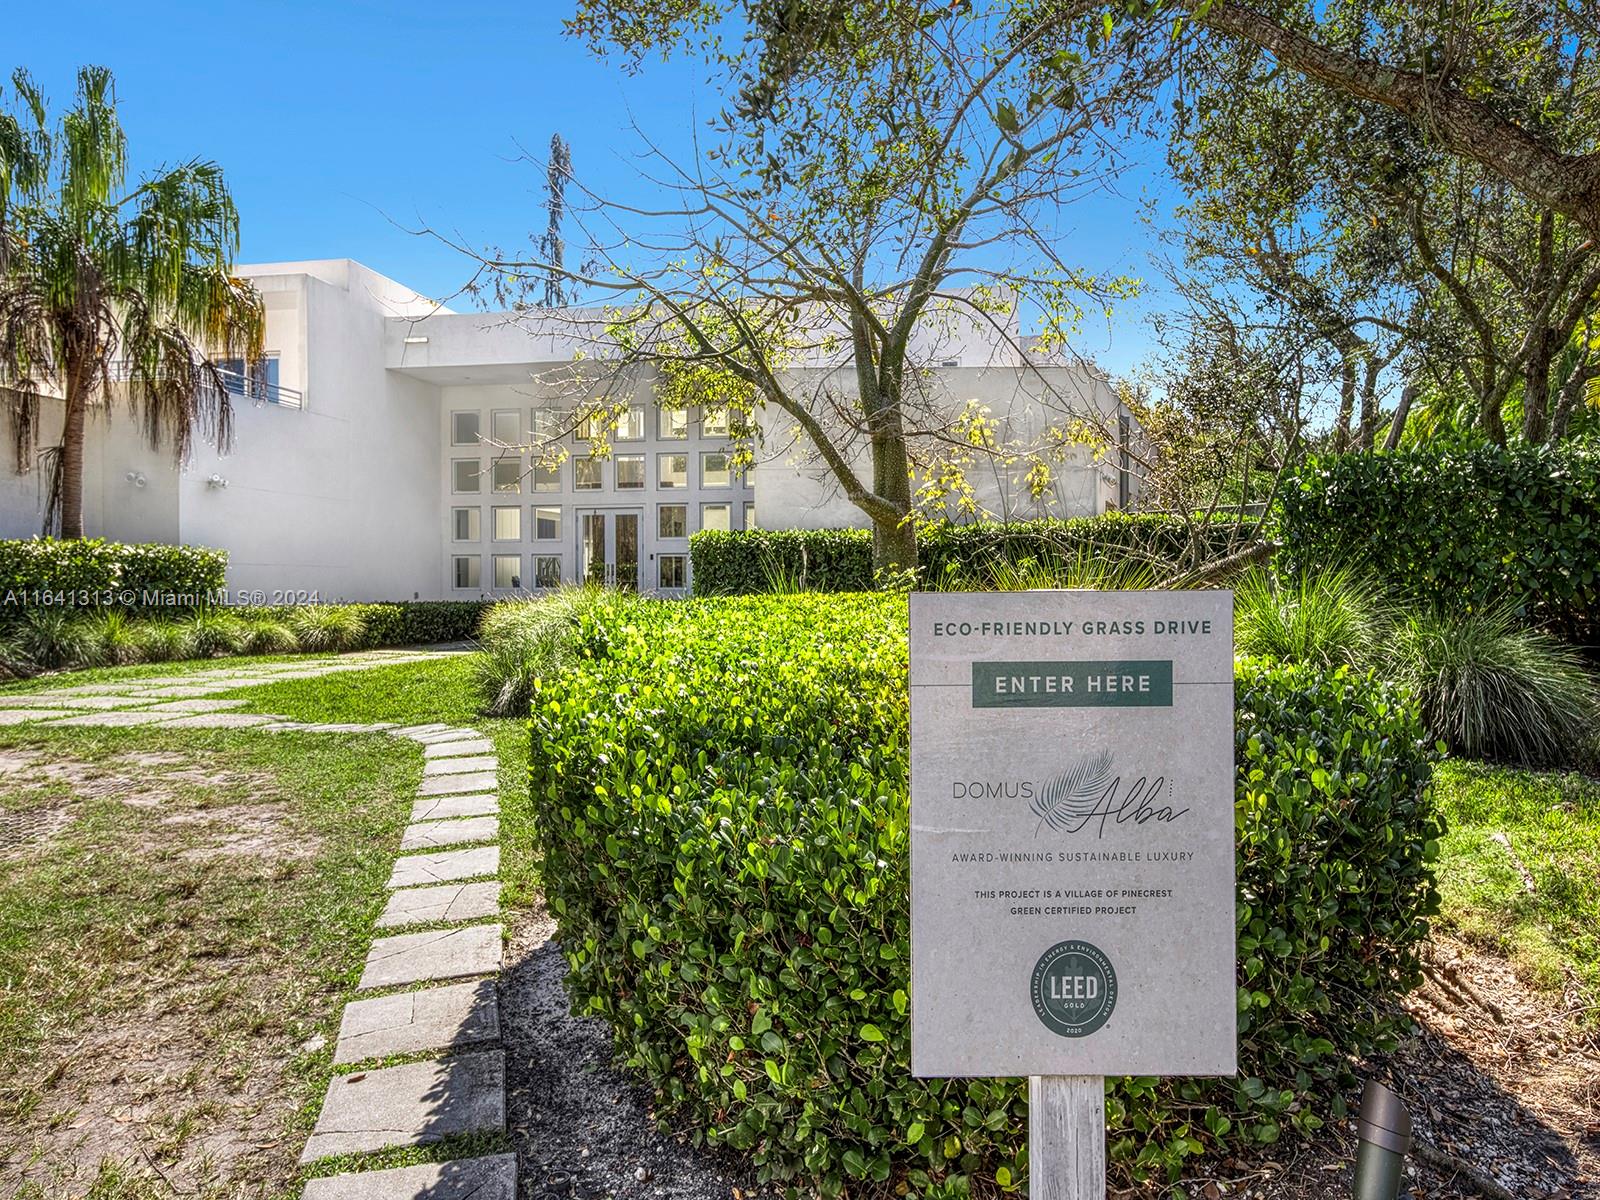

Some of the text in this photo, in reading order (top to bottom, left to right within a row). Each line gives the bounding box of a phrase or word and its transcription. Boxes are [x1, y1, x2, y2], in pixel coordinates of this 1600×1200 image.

[933, 620, 1212, 636] ECO-FRIENDLY GRASS DRIVE
[995, 675, 1151, 693] ENTER HERE
[952, 776, 1190, 839] DOMUS Alba
[951, 851, 1195, 863] AWARD-WINNING SUSTAINABLE LUXURY
[974, 889, 1173, 899] THIS PROJECT IS A VILLAGE OF PINECREST
[1010, 906, 1137, 915] GREEN CERTIFIED PROJECT
[1050, 975, 1098, 999] LEED
